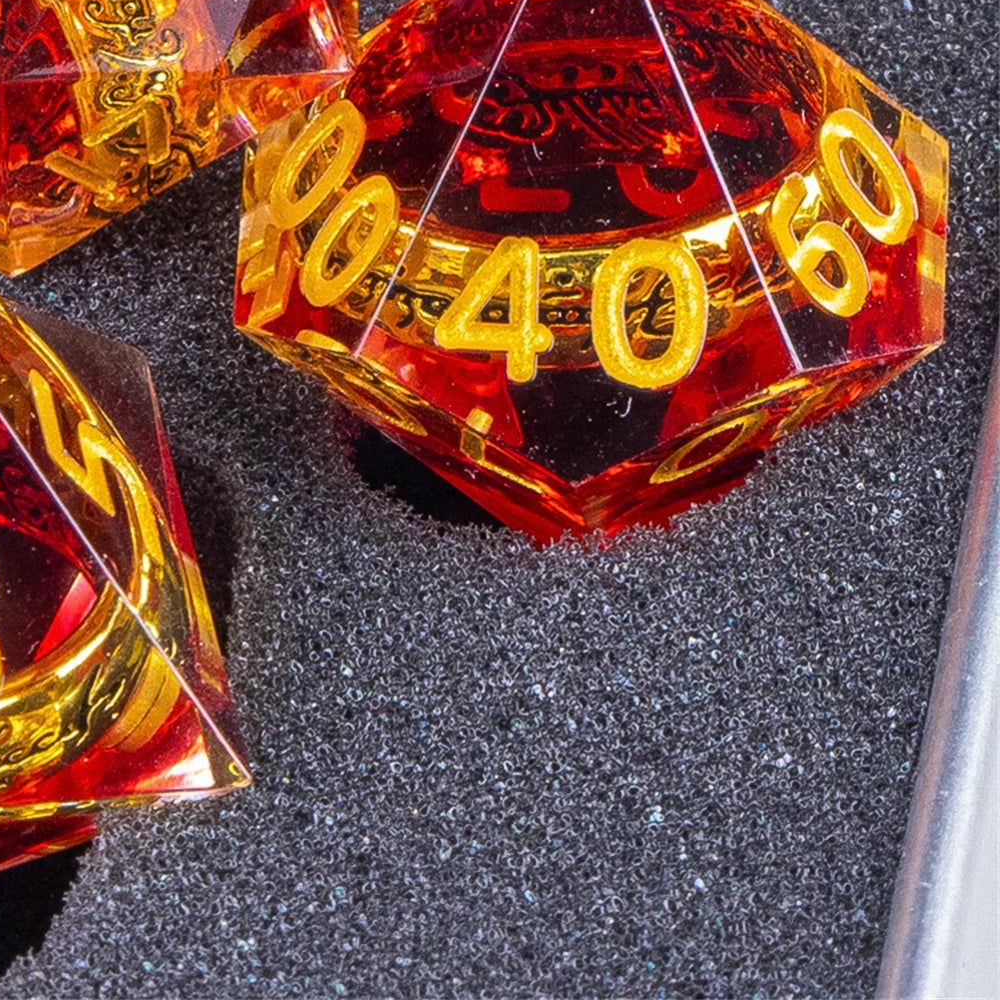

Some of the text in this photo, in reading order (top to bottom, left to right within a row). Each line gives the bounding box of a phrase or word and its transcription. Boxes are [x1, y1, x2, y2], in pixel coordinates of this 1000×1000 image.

[269, 98, 399, 308] 00
[766, 107, 917, 318] 60
[433, 236, 708, 389] 40
